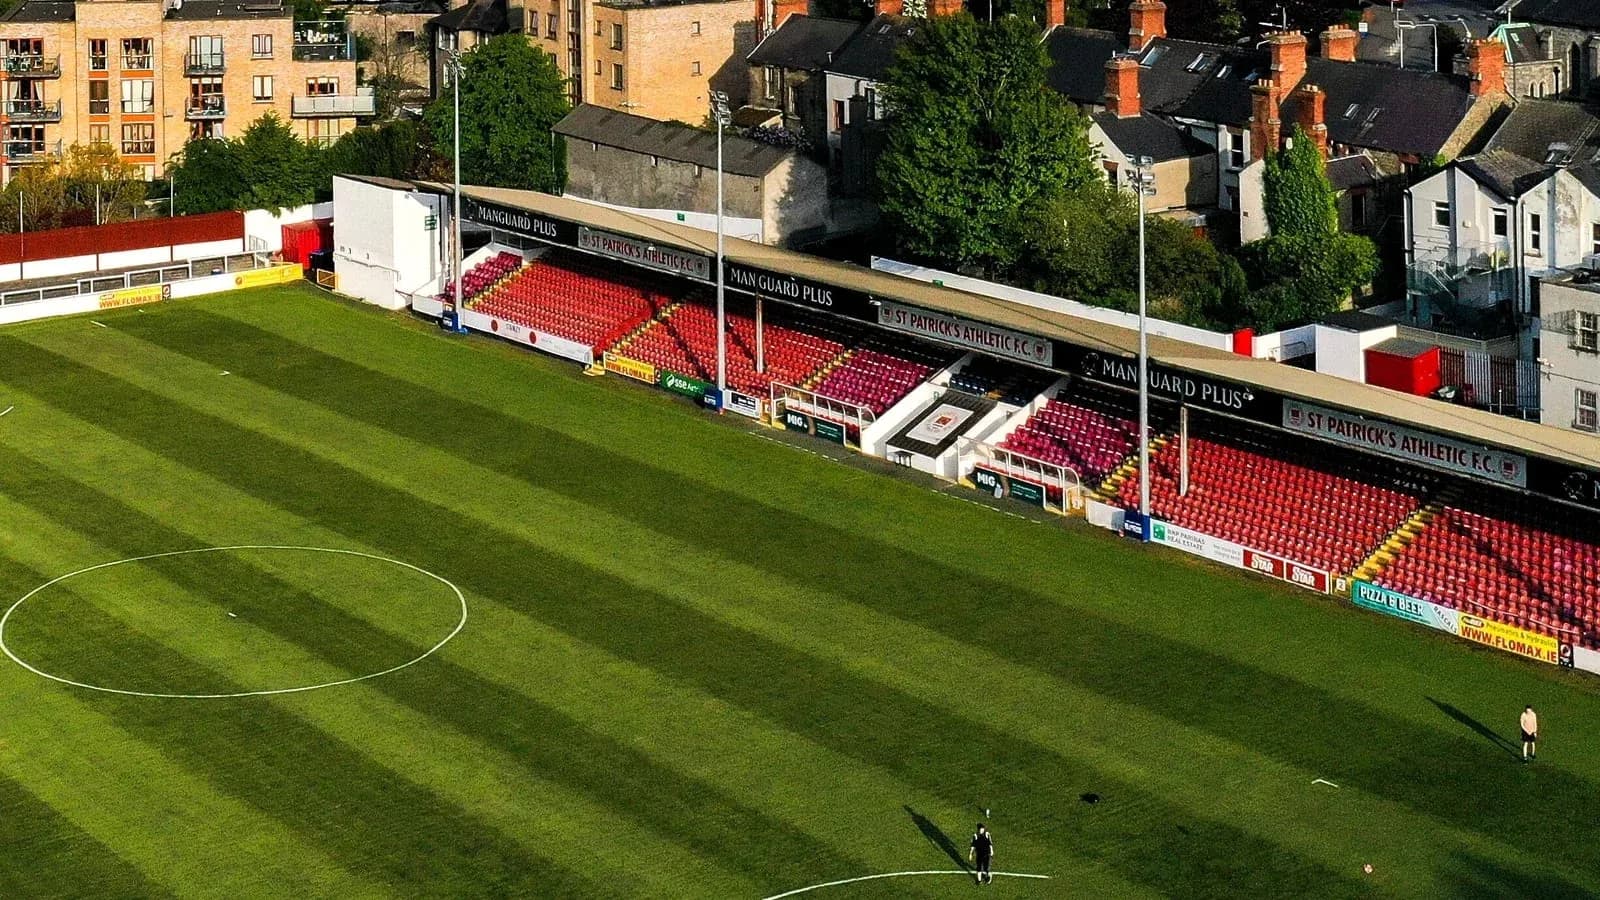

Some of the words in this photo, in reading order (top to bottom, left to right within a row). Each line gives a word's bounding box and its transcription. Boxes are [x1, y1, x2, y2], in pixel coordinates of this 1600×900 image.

[478, 205, 531, 230] MANGUARD
[533, 218, 557, 237] PLUS
[591, 235, 600, 247] ST
[602, 238, 641, 259] PATRICK'S
[643, 249, 679, 268] ATHLETIC
[803, 285, 833, 306] PLUS
[895, 309, 907, 325] ST
[910, 315, 961, 338] PATRICK'S
[963, 327, 1011, 350] ATHLETIC
[1102, 359, 1196, 397] MANUARD
[1202, 383, 1242, 409] PLUS
[1308, 411, 1323, 429] ST
[1327, 416, 1397, 449] PATRICK'S
[1401, 435, 1469, 467] ATHLETIC
[1251, 553, 1274, 573] STAR
[1292, 566, 1315, 586] STAR
[1360, 585, 1387, 605] PIZZA
[1399, 597, 1424, 616] BEER
[1461, 625, 1557, 662] WWW.FLOMAX.IE
